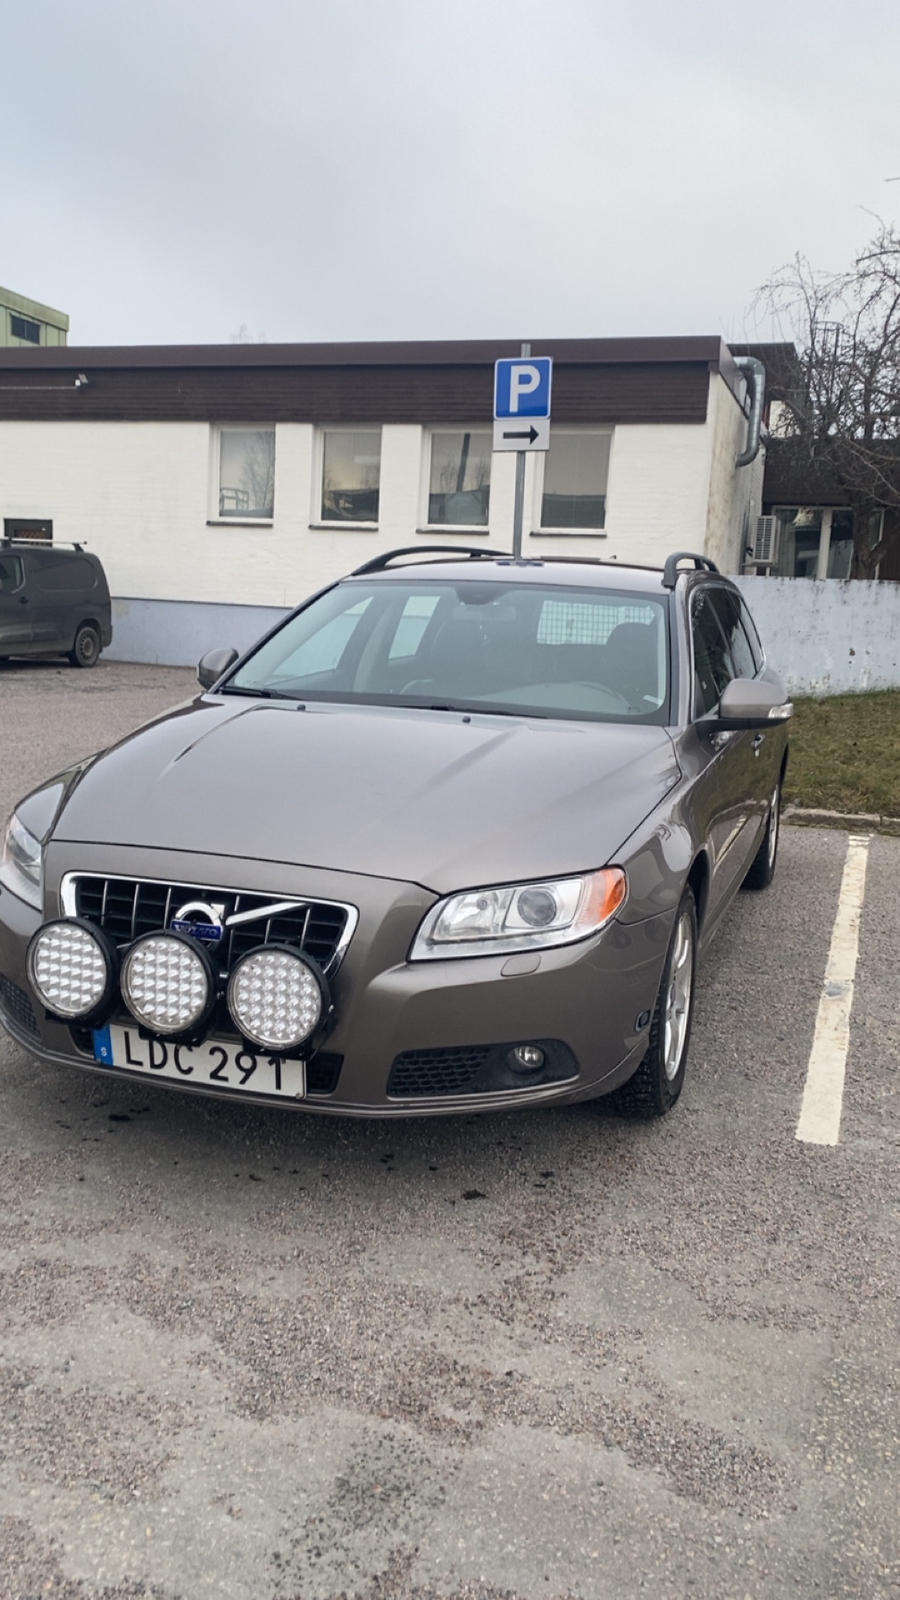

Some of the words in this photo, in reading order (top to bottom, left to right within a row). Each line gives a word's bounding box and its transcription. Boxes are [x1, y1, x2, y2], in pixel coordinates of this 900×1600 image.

[509, 365, 540, 413] P
[124, 1031, 194, 1075] LDC
[209, 1046, 282, 1090] 291
